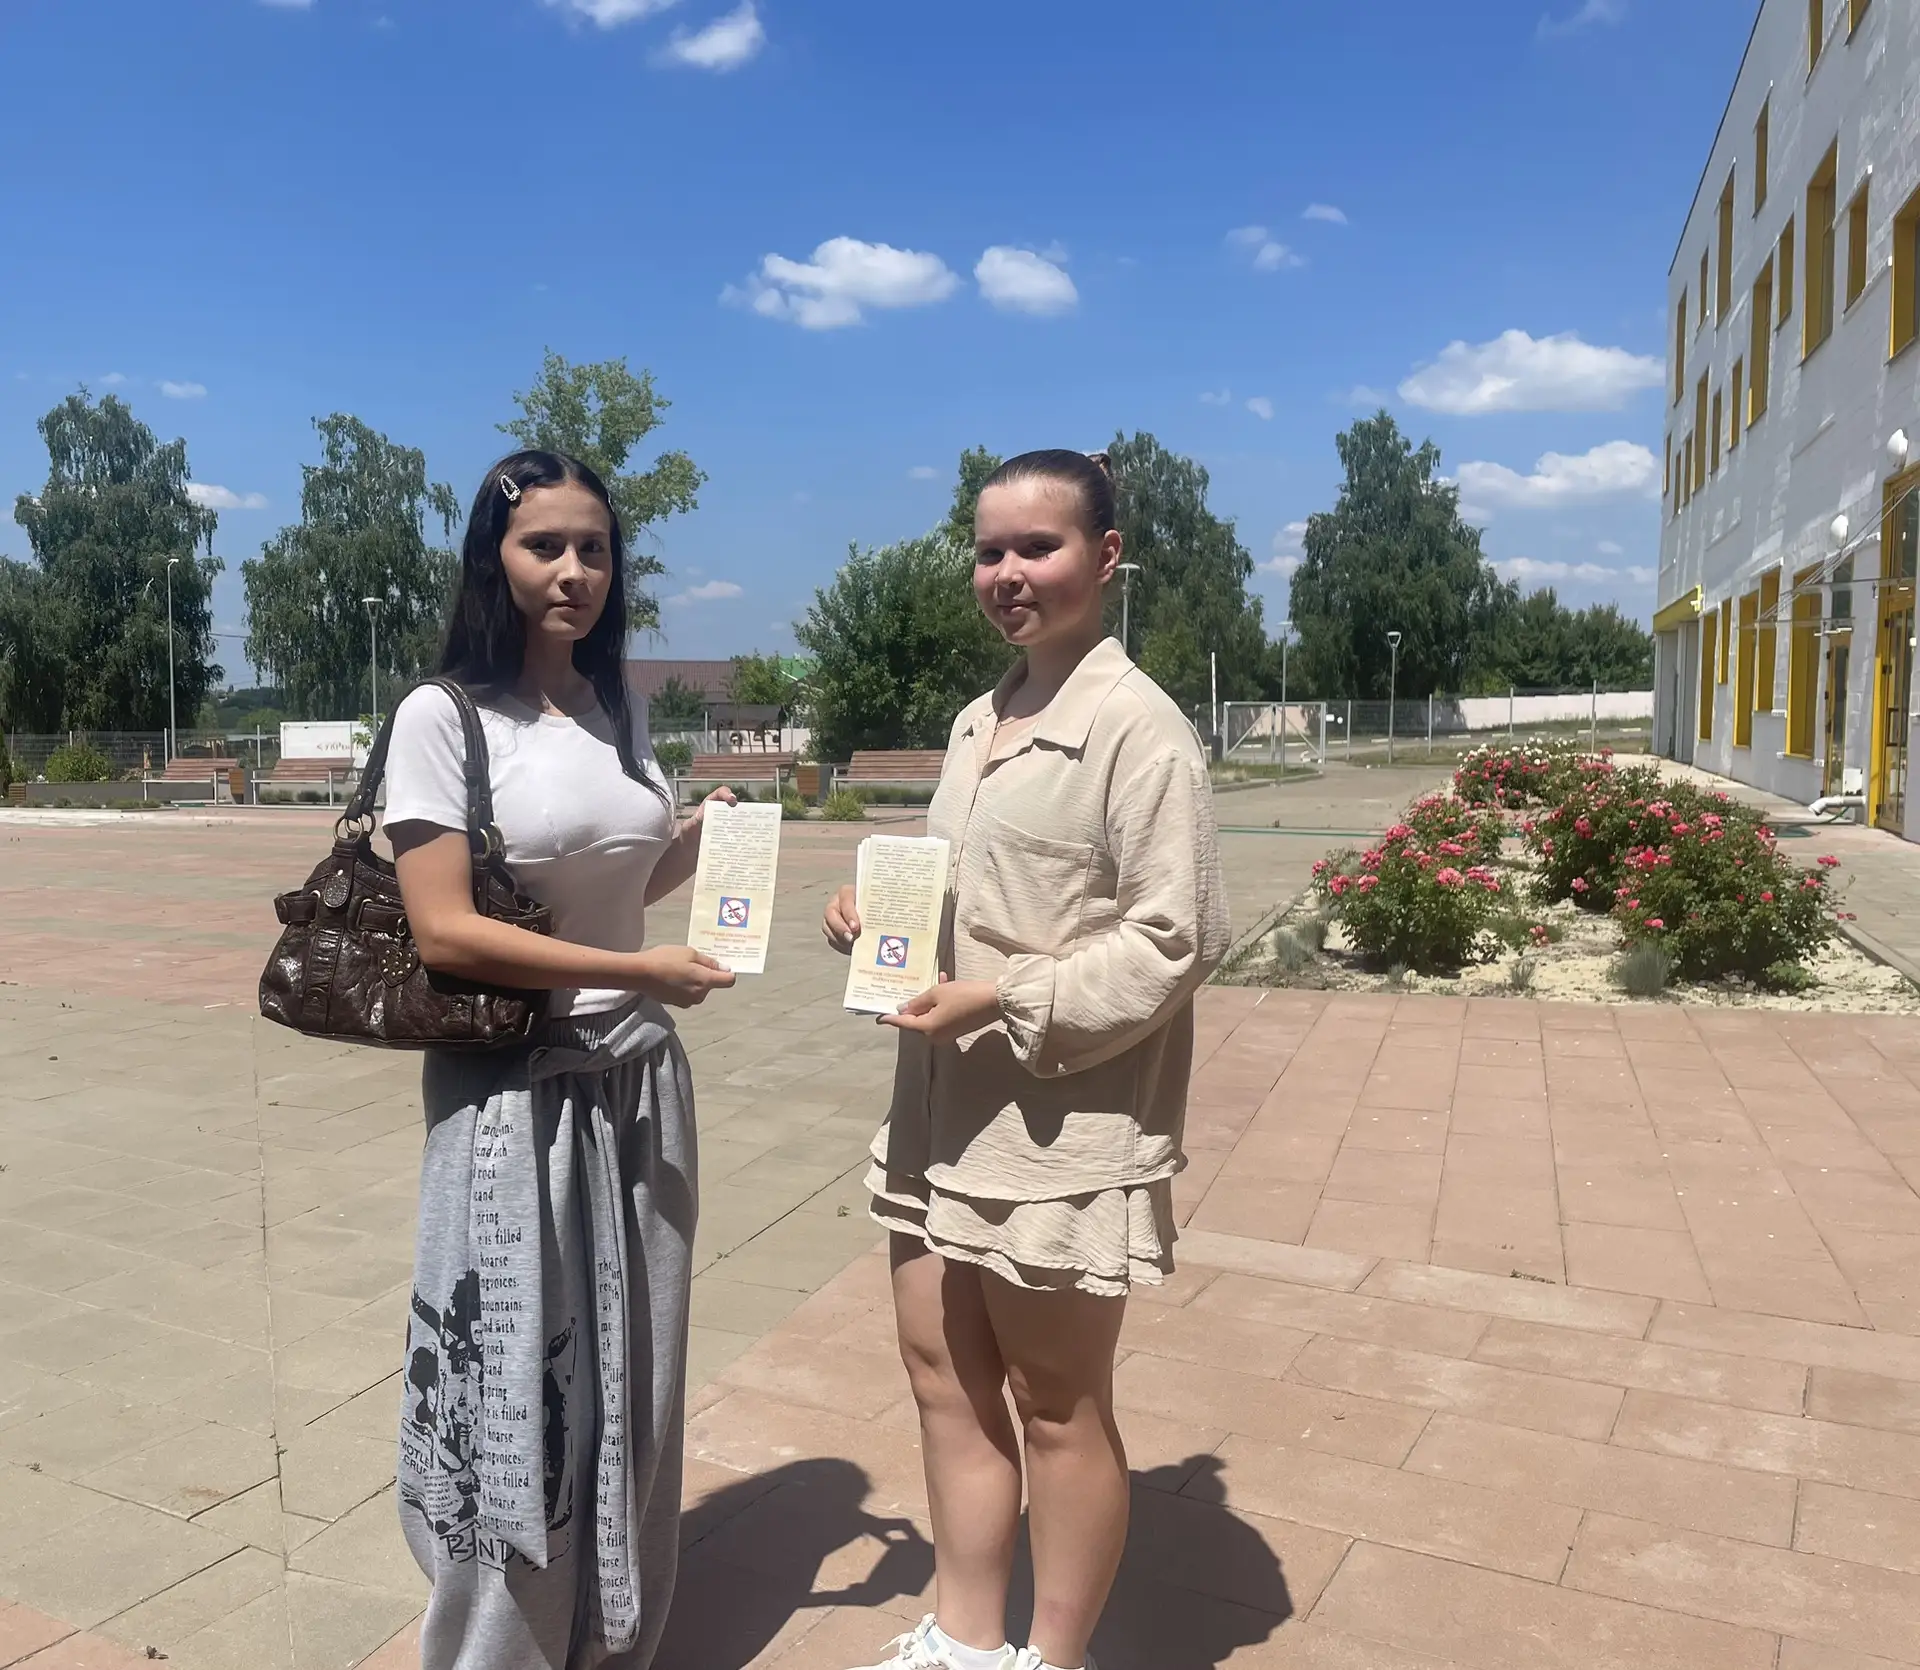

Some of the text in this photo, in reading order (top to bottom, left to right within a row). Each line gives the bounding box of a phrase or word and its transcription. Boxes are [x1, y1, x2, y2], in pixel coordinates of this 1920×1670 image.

[495, 1227, 521, 1245] filled
[501, 1404, 527, 1421] filled
[503, 1471, 529, 1488] filled
